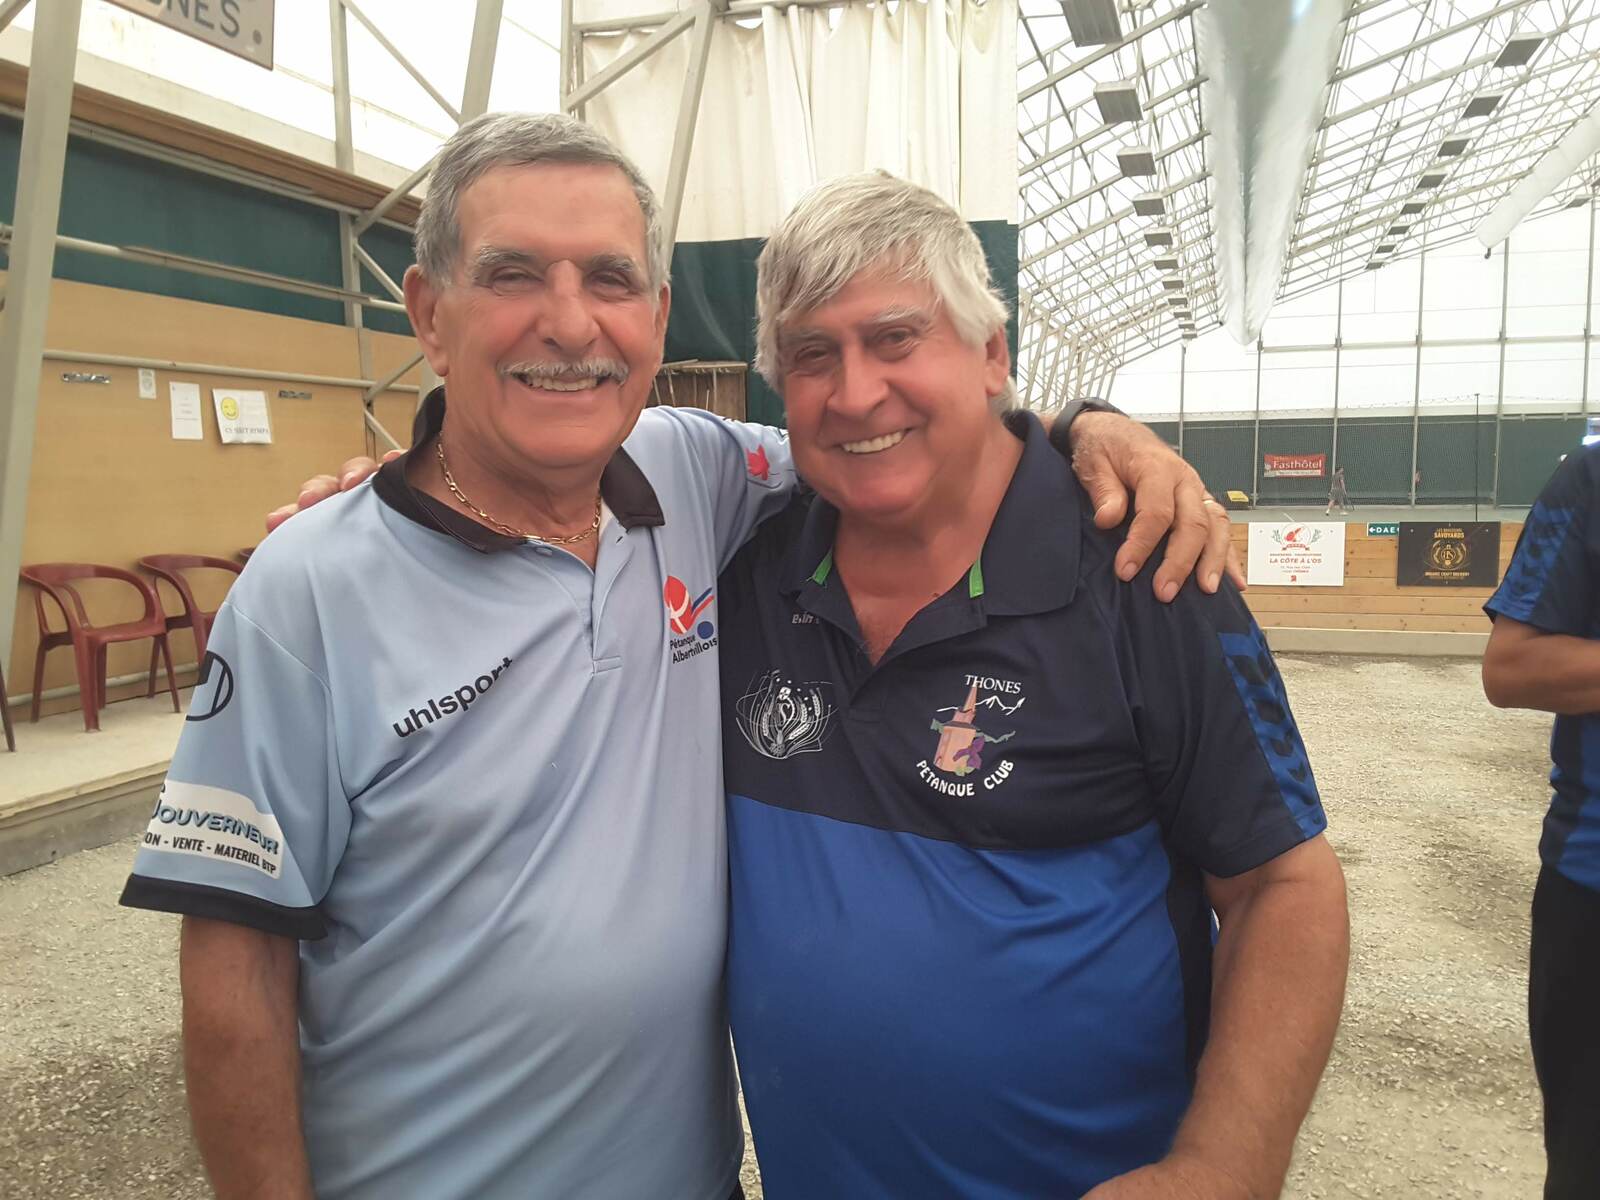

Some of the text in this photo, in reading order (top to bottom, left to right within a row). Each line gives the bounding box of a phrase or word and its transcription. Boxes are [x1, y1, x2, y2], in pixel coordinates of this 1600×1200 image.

[1273, 459, 1322, 469] Fasthôtel
[1376, 526, 1396, 534] DAE
[1280, 556, 1298, 564] CÔTE
[670, 634, 695, 650] Pétanque
[964, 674, 1022, 695] THONES
[392, 656, 513, 738] uhlsport
[916, 759, 1014, 797] PETANQUE CLUB
[172, 836, 205, 852] VENTE
[213, 843, 261, 867] MATERIEL
[262, 859, 276, 874] BTP
